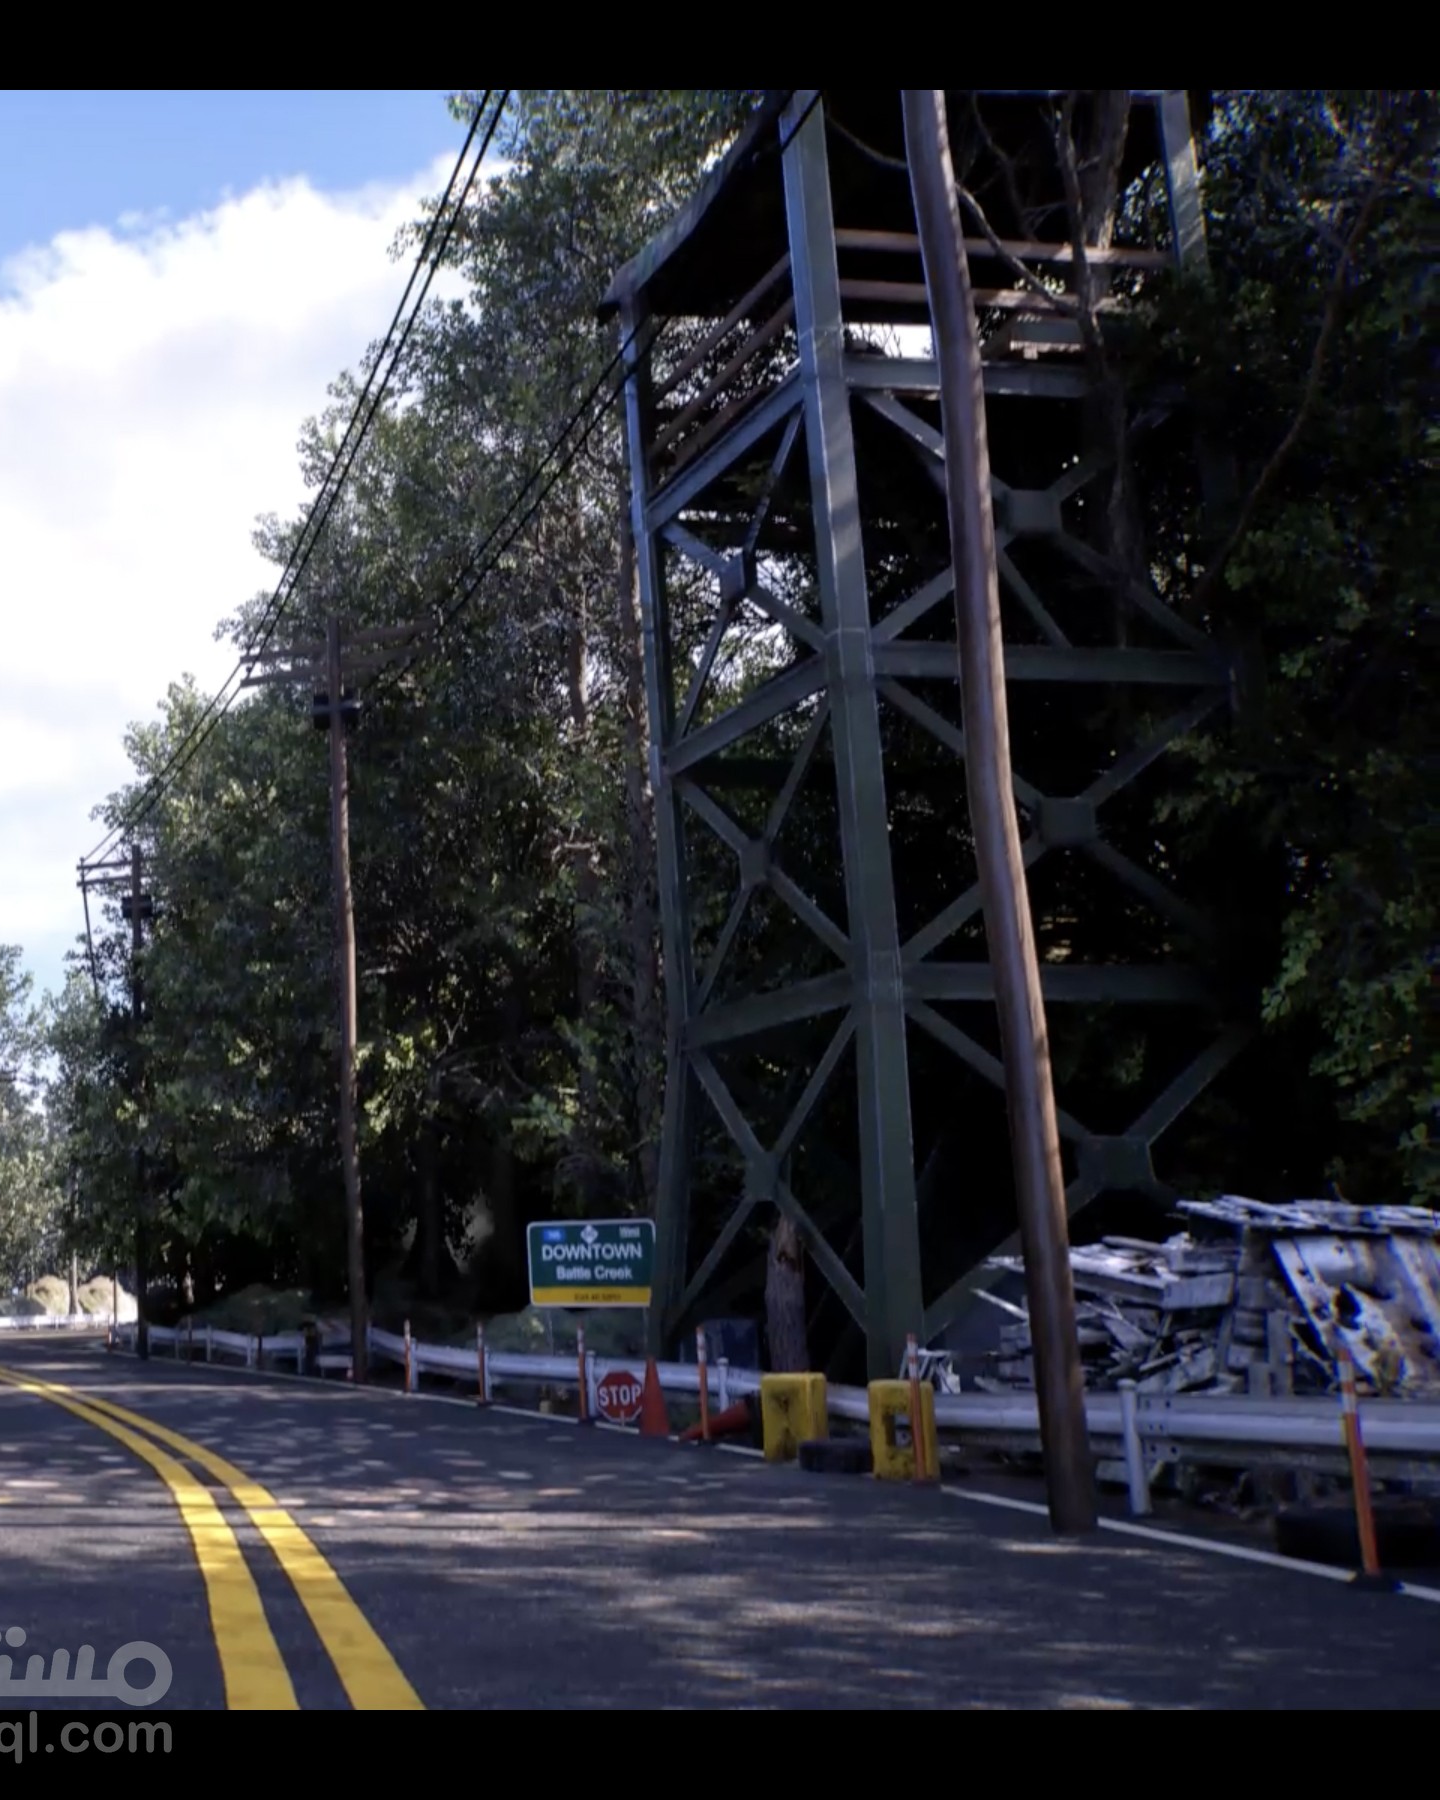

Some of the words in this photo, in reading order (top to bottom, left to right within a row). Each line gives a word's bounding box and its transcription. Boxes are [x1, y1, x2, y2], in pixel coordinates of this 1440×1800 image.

[542, 1243, 642, 1261] DOWNTOWN
[556, 1266, 591, 1280] Battle
[594, 1265, 632, 1280] Creek
[599, 1384, 641, 1406] STOP
